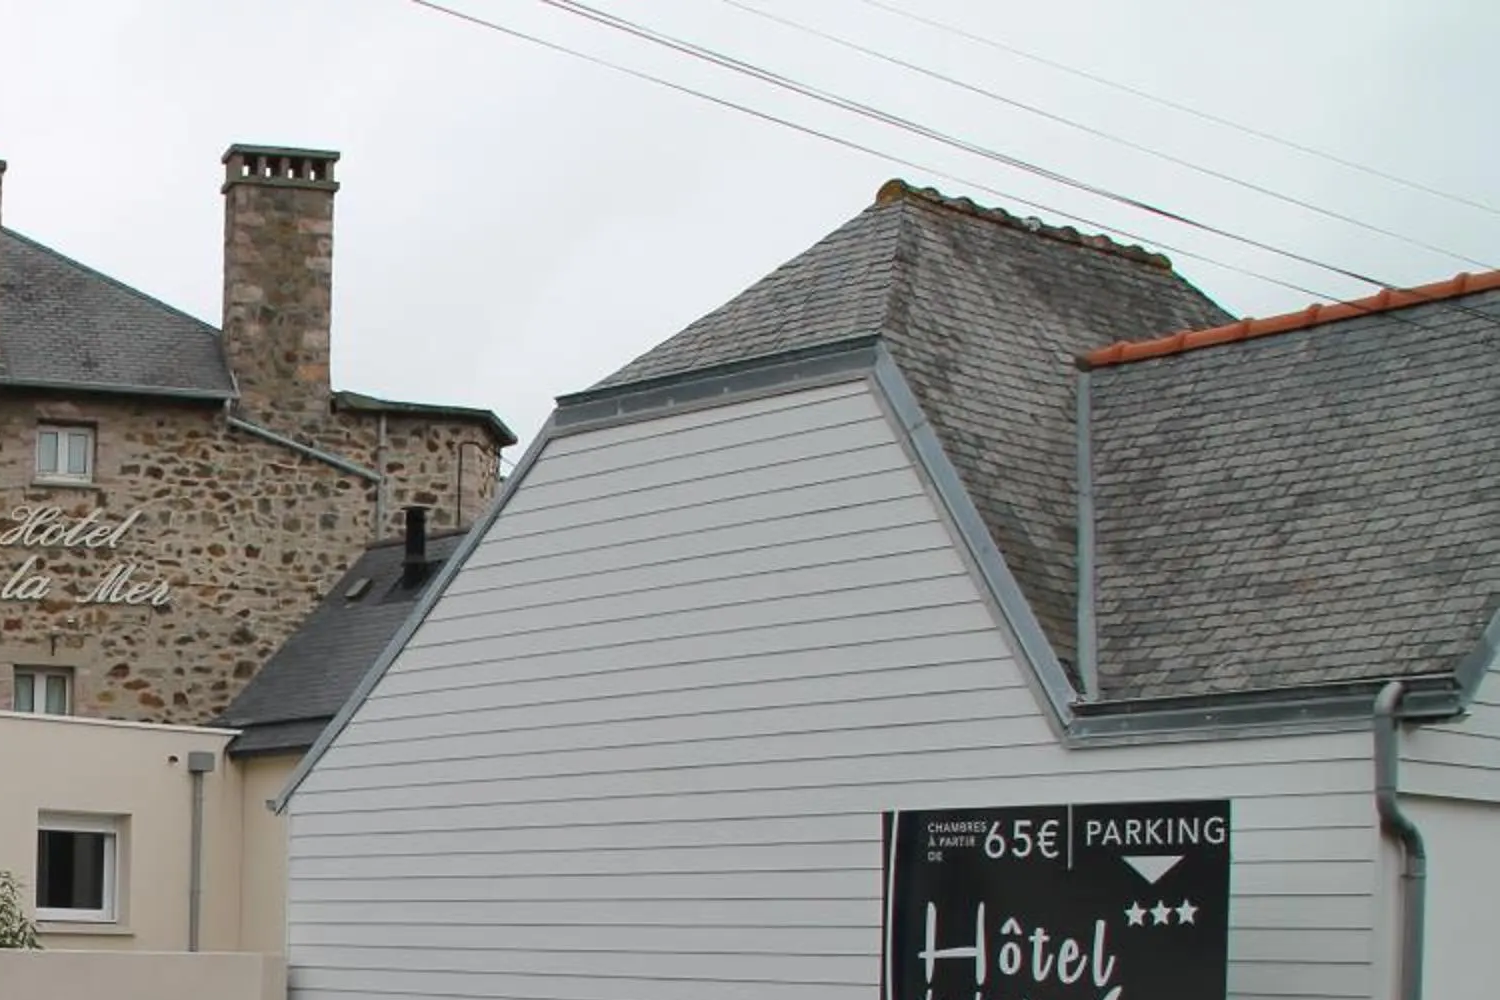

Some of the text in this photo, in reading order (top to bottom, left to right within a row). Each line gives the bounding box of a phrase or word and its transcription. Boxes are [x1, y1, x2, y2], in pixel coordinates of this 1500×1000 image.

[1, 554, 51, 599] la
[76, 563, 171, 606] Mer
[927, 820, 987, 833] CHAMBRES
[939, 836, 976, 847] PARTIR
[985, 818, 1060, 859] 65€
[1086, 816, 1226, 846] PARKING
[927, 851, 943, 862] DE
[917, 901, 1115, 987] Hôtel
